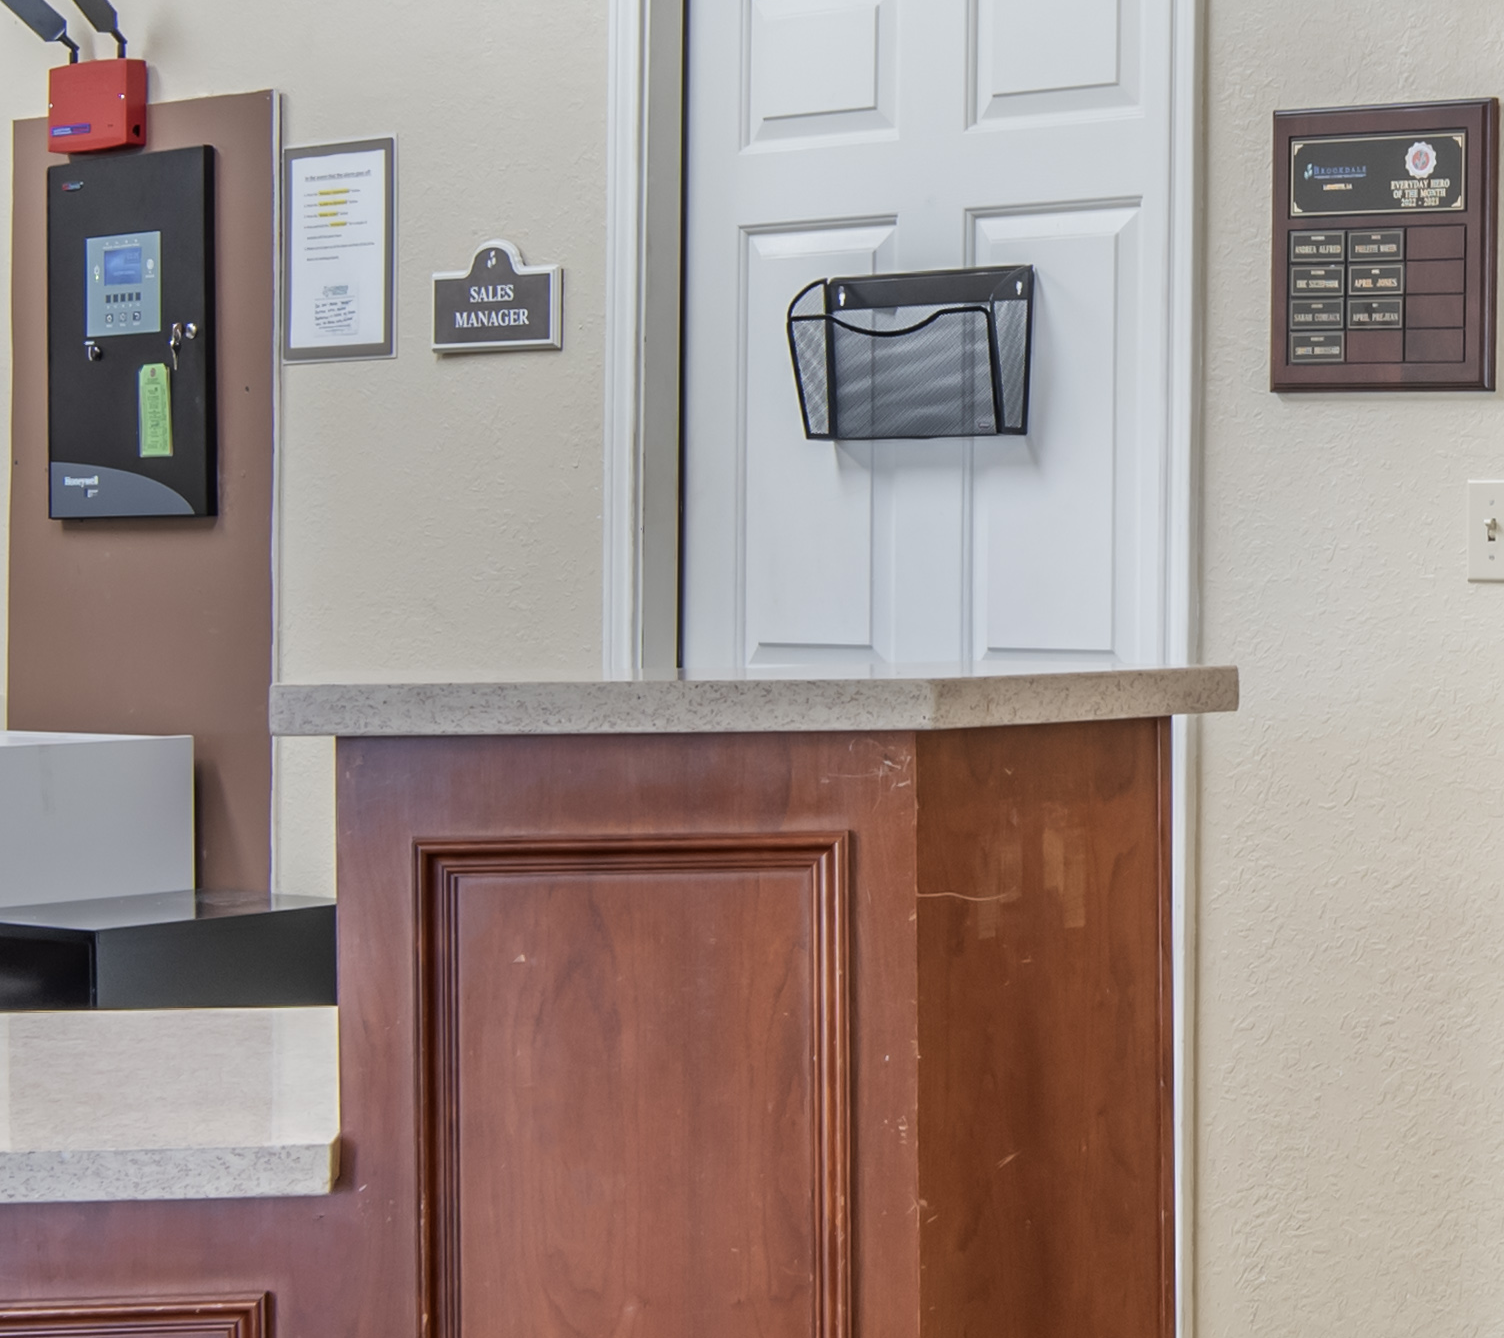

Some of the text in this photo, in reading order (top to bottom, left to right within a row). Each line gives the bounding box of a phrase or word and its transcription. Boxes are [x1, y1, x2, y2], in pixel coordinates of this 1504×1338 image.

[1391, 178, 1450, 190] EVERYDAY HERO
[1393, 188, 1446, 199] OF THE MONTH
[469, 284, 514, 303] SALES
[454, 308, 529, 328] MANAGER
[64, 475, 99, 487] Honeywell
